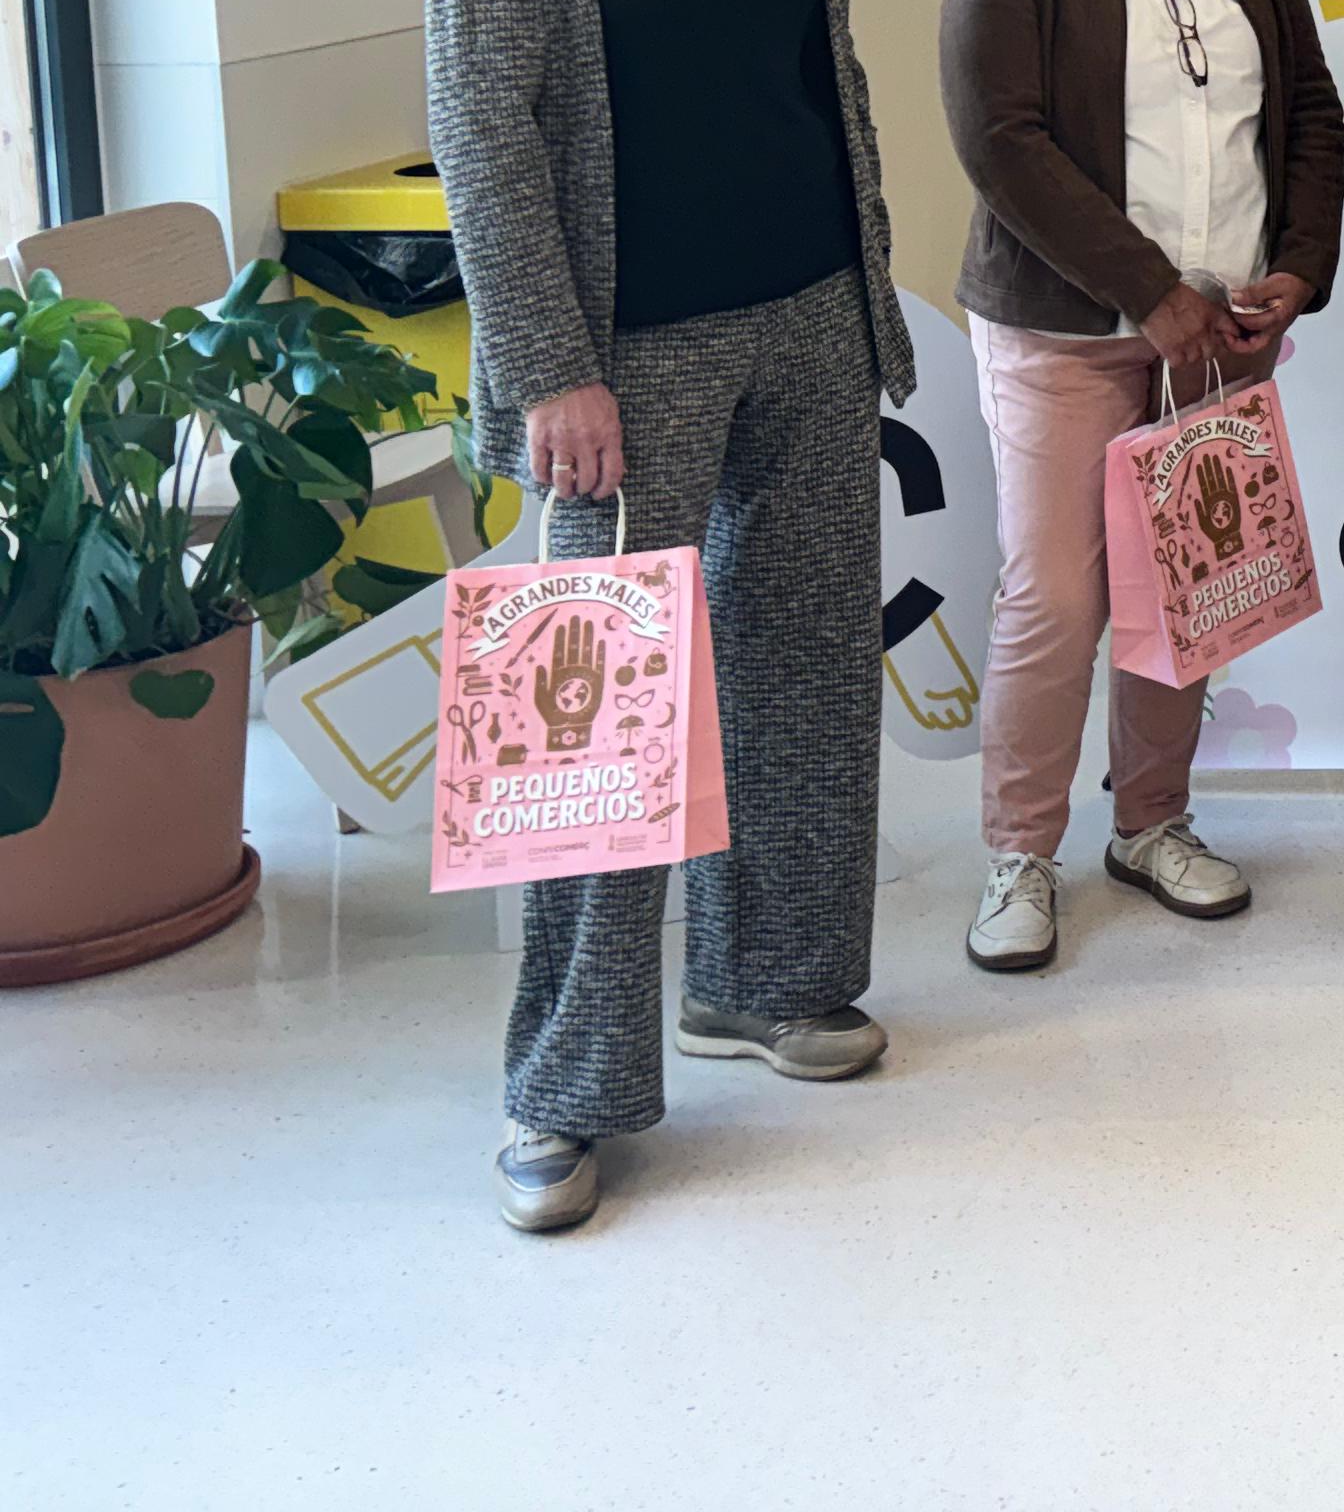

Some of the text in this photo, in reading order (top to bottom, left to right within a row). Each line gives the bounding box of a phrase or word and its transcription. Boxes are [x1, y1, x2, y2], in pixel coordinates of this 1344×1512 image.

[1164, 420, 1212, 473] GRANDES
[1215, 419, 1258, 444] MALES
[488, 576, 658, 633] A GRANDES MALES
[1188, 569, 1293, 639] COMERCIOS
[1190, 551, 1283, 613] PEQUEÑOS
[490, 761, 637, 805] PEQUEÑOS
[473, 791, 647, 838] COMERCIOS
